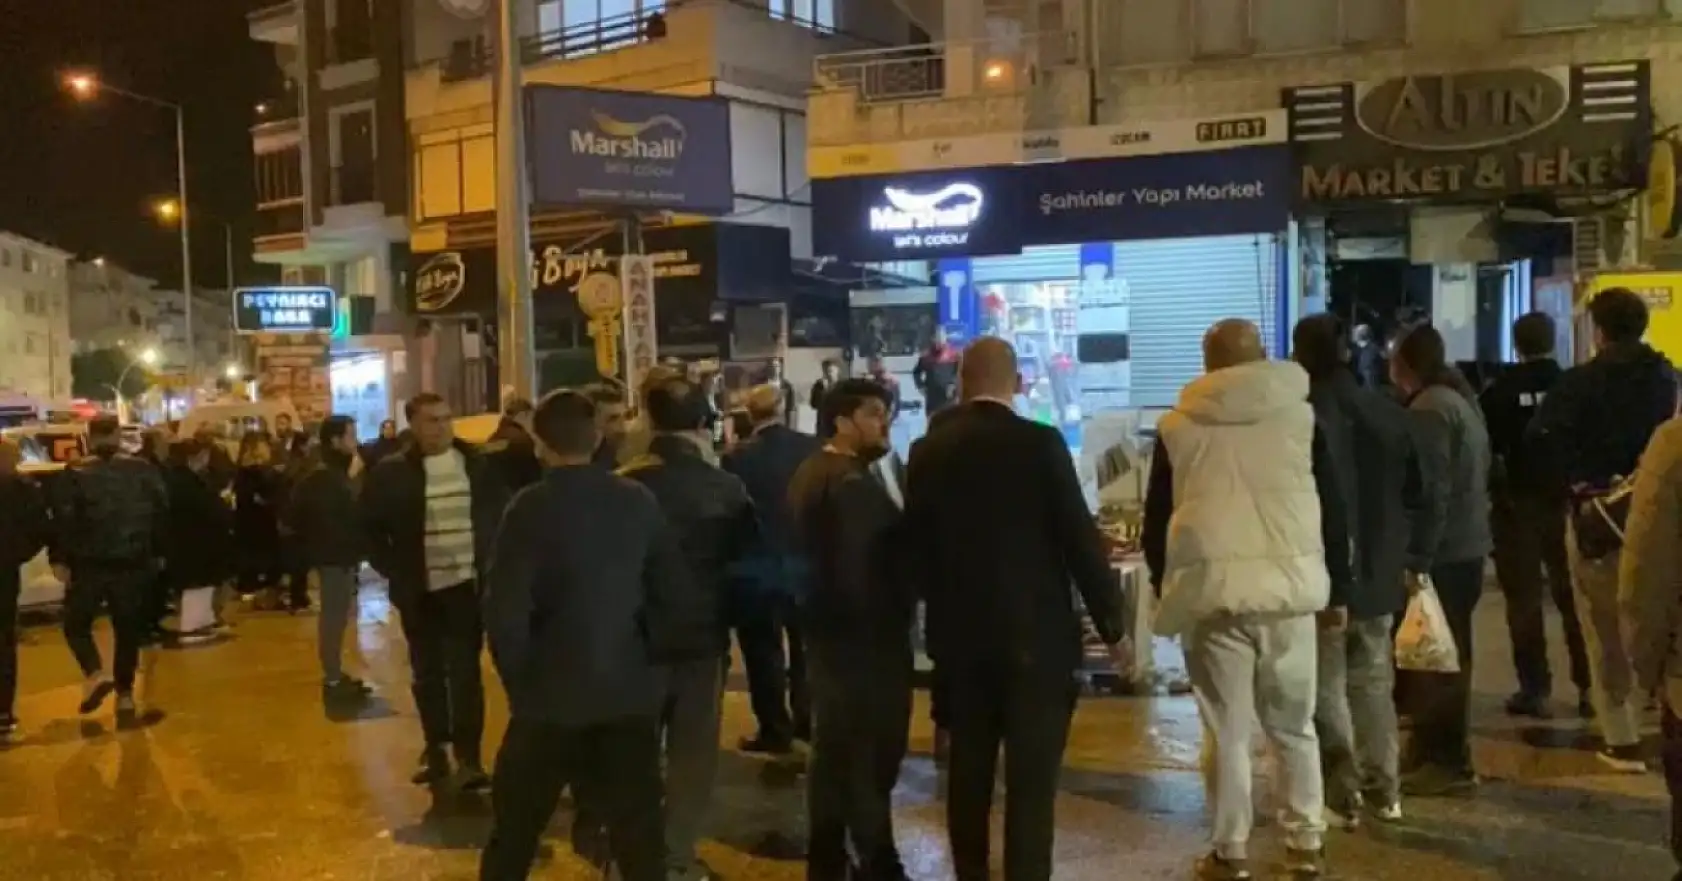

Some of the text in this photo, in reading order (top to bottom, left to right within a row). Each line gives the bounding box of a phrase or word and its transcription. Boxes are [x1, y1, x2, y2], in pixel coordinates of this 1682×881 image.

[569, 129, 677, 159] Marshall
[1302, 157, 1465, 199] MARKET
[1473, 153, 1504, 189] &
[1039, 179, 1265, 215] Şahinler Yapı Market
[869, 204, 970, 231] Marshall
